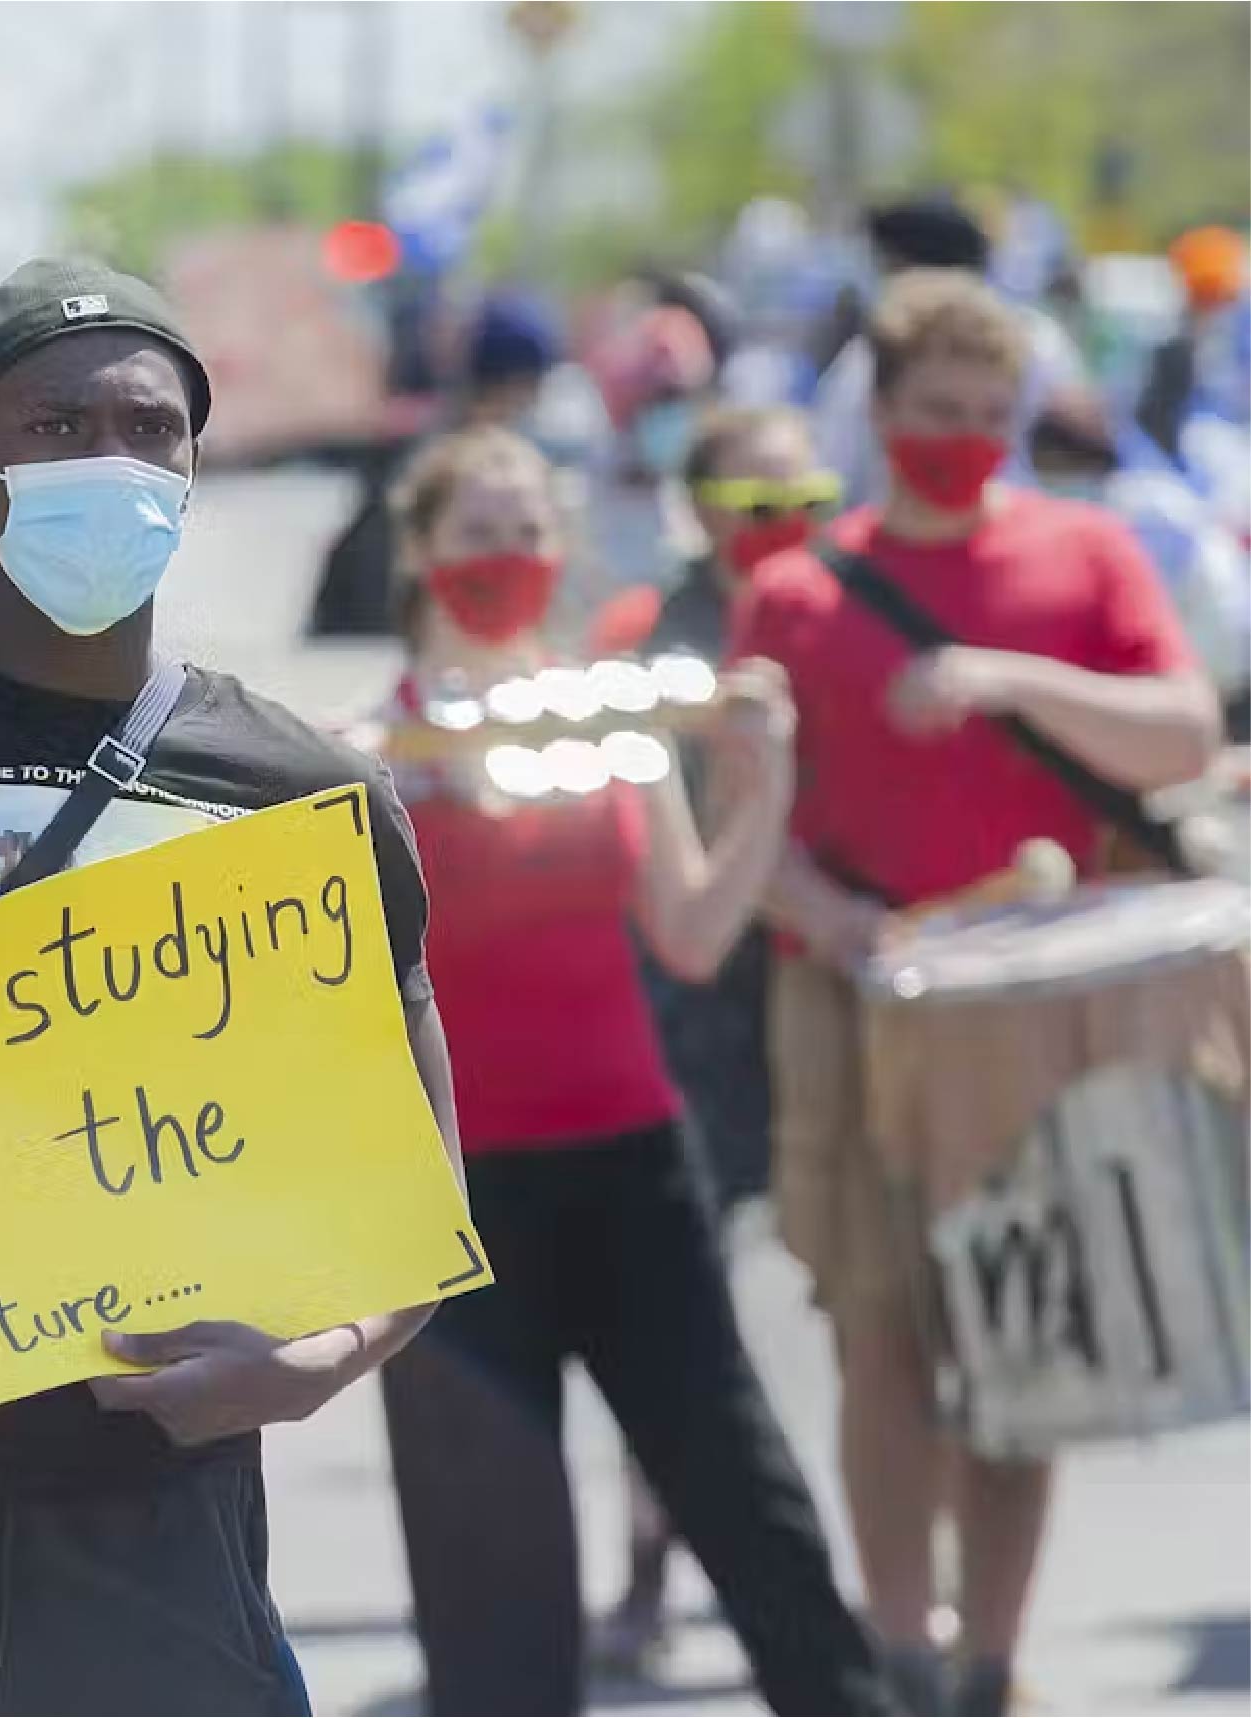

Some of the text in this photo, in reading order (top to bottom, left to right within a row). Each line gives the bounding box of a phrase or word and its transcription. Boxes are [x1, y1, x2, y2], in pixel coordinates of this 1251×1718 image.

[20, 766, 49, 781] TO
[54, 766, 87, 785] TH
[5, 874, 354, 1046] studying
[53, 1085, 246, 1195] the
